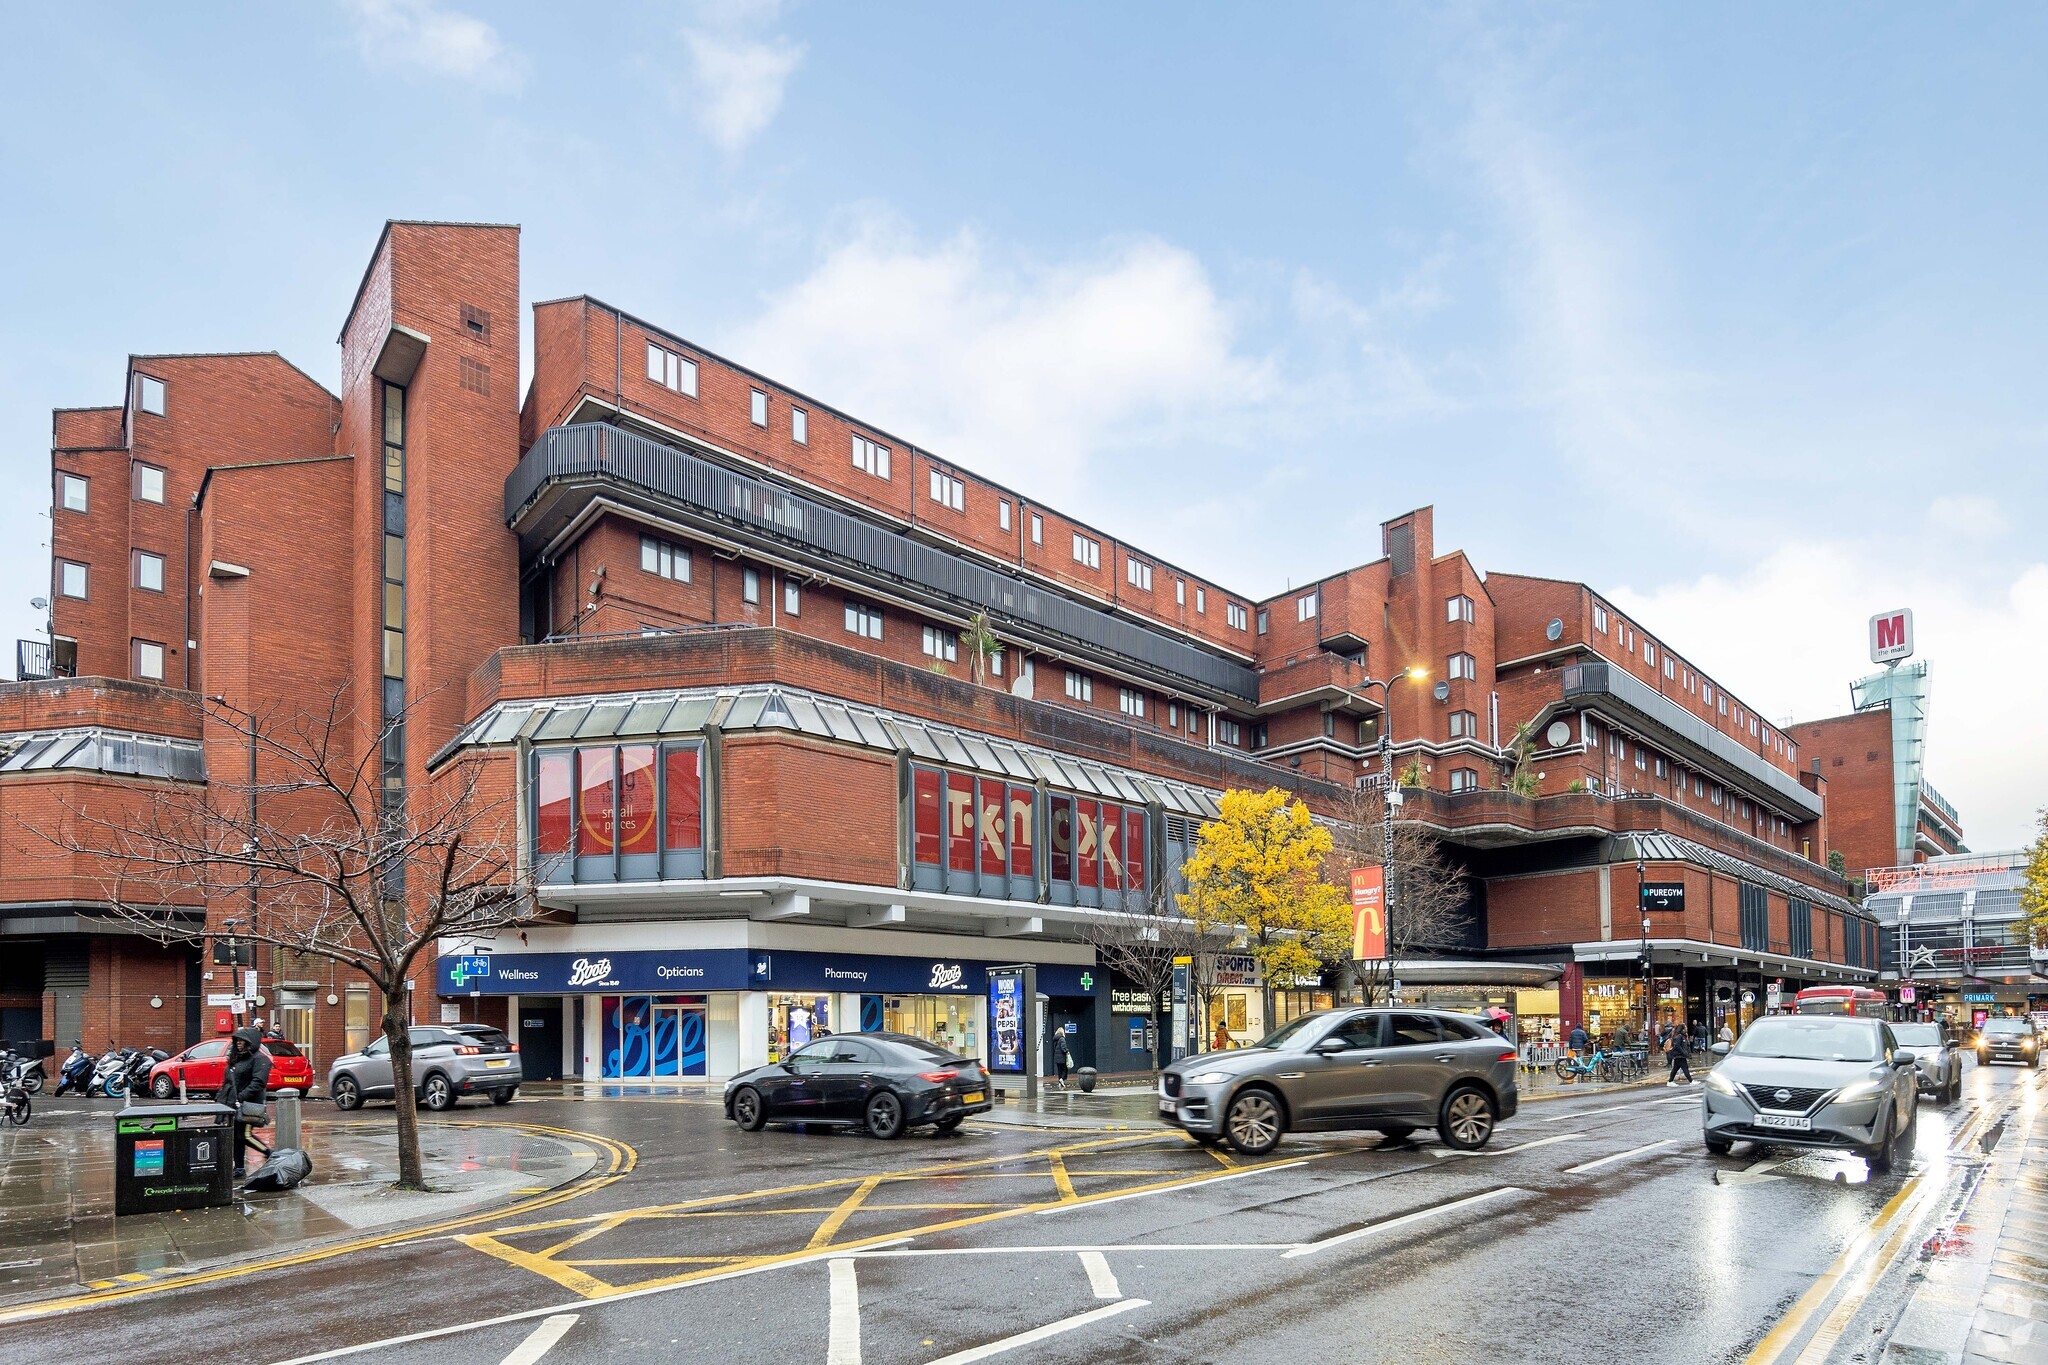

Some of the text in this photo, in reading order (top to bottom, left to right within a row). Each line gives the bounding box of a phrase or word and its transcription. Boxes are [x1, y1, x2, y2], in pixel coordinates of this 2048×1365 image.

[1877, 614, 1905, 649] M
[1891, 645, 1905, 653] mall
[605, 820, 636, 833] prces
[1869, 863, 2009, 881] Merry Christmas
[1354, 886, 1381, 896] Hungry?
[1649, 888, 1683, 897] PUREGYM
[1216, 956, 1255, 972] SPORTS
[498, 969, 539, 980] Wellness
[568, 958, 612, 987] Boots
[656, 965, 704, 980] Opticians
[824, 967, 868, 982] Pharmacy
[928, 963, 962, 989] Boots
[1112, 989, 1152, 1002] free cash
[1162, 990, 1171, 998] 24
[1598, 984, 1616, 997] PRET
[1902, 988, 1912, 999] M
[1963, 994, 1995, 1002] PRIMARK
[1112, 1002, 1152, 1012] withdrawals
[997, 1020, 1016, 1028] PEPSI
